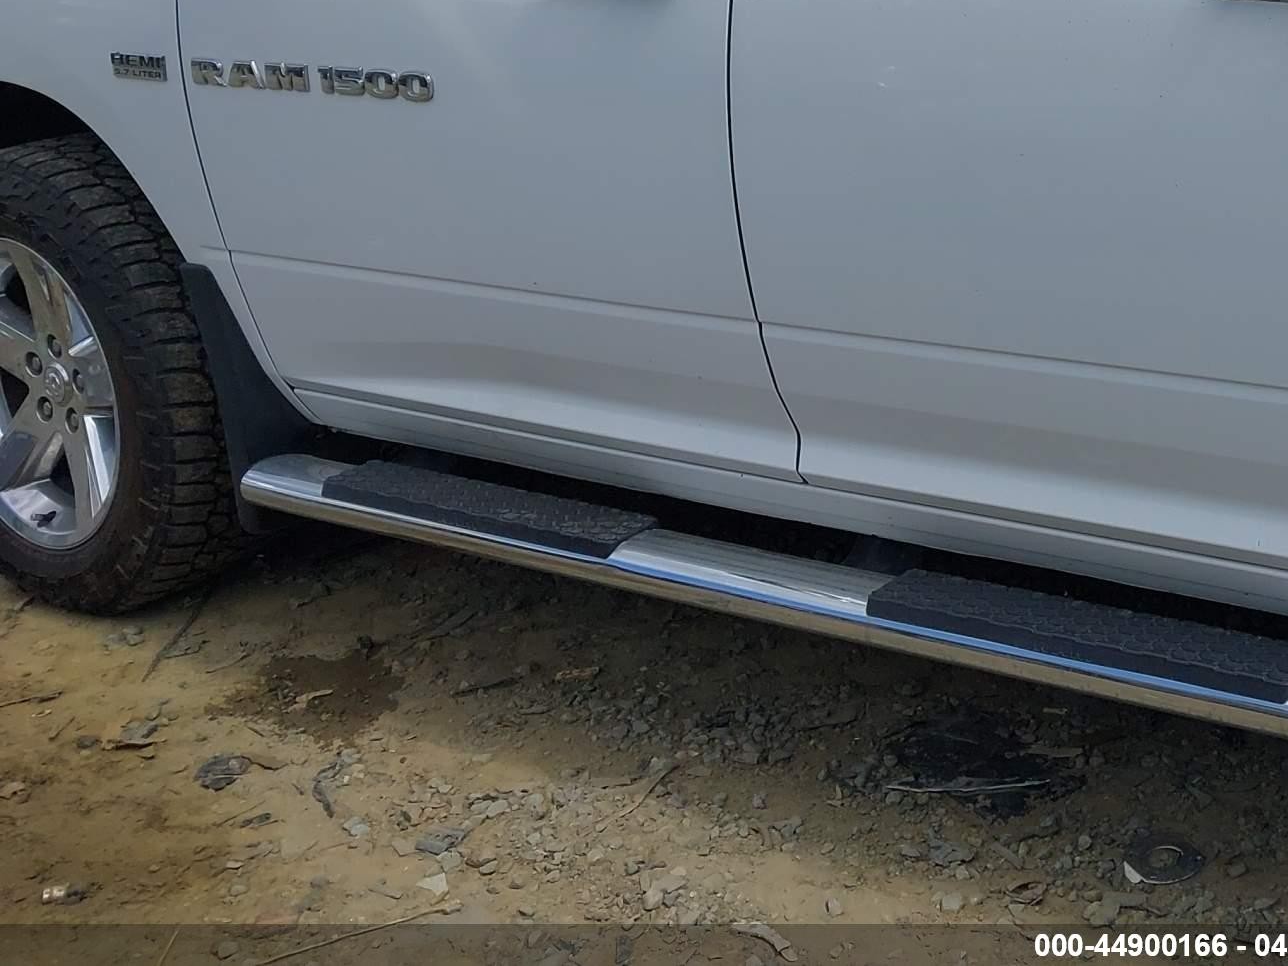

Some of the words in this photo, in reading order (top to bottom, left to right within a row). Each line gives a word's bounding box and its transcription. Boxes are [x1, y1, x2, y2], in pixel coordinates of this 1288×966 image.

[110, 52, 162, 68] HEMI
[132, 69, 162, 79] LITER
[190, 57, 310, 93] RAM
[317, 64, 435, 103] 1500
